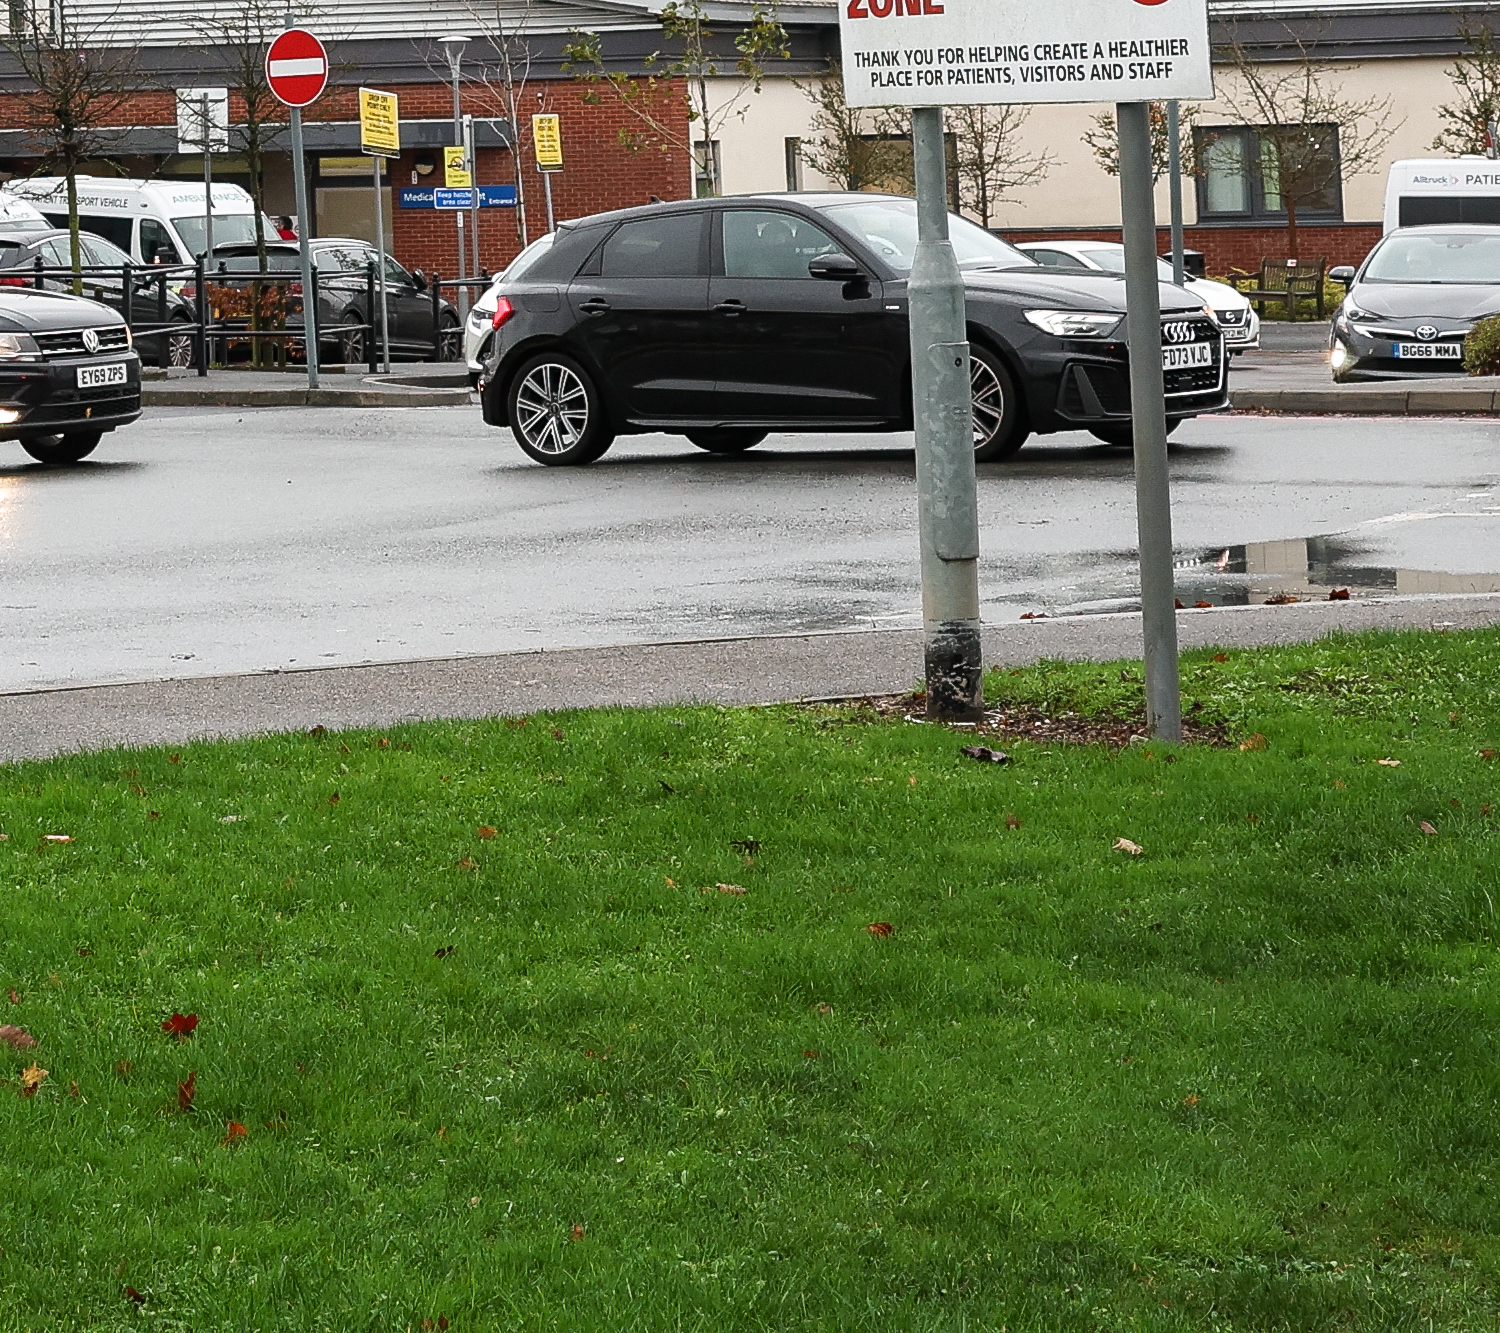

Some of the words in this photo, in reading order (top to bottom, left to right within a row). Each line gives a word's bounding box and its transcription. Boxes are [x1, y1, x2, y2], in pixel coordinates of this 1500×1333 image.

[854, 49, 900, 68] THANK
[904, 48, 934, 66] YOU
[937, 47, 964, 65] FOR
[969, 45, 1029, 63] HELPING
[1034, 42, 1088, 61] CREATE
[1093, 42, 1104, 59] A
[1109, 39, 1189, 57] HEALTHIER
[871, 69, 913, 87] PLACE
[917, 69, 943, 86] FOR
[948, 67, 1015, 86] PATIENTS,
[1019, 65, 1085, 83] VISITORS
[1090, 64, 1124, 81] AND
[1128, 63, 1173, 80] STAFF
[59, 196, 100, 208] TRSPORT
[100, 197, 128, 208] VEHICLE
[172, 193, 243, 204] AMBUANCE
[1162, 347, 1188, 367] FD73
[1190, 345, 1208, 363] VJC
[1402, 345, 1432, 356] BG66
[82, 368, 106, 385] EY69
[107, 366, 124, 382] ZPS
